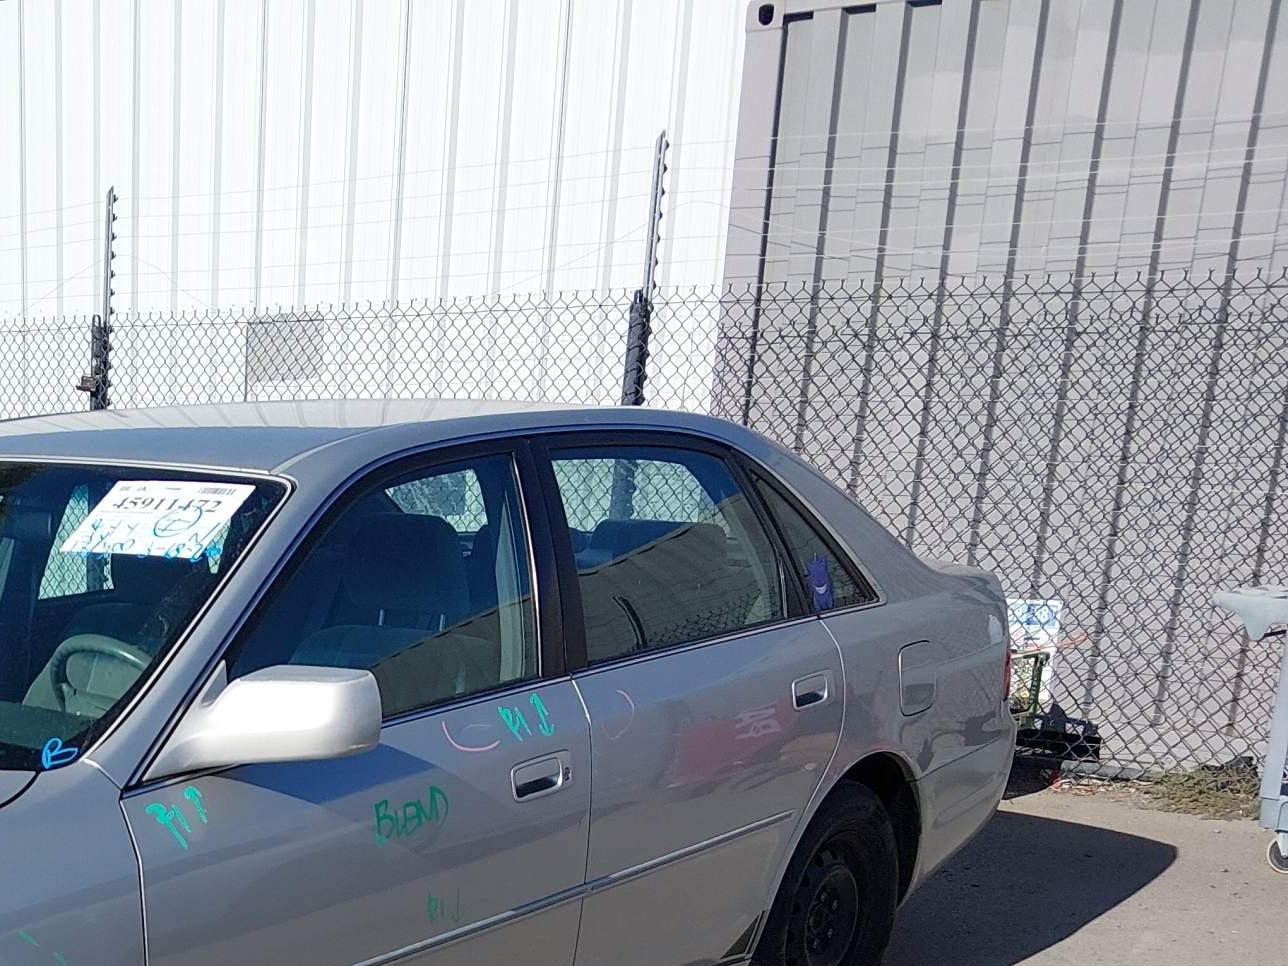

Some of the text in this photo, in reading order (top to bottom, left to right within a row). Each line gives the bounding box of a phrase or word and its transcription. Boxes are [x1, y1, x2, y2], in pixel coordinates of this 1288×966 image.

[112, 495, 222, 513] 45911472
[41, 737, 79, 769] B
[374, 785, 449, 844] BLEND
